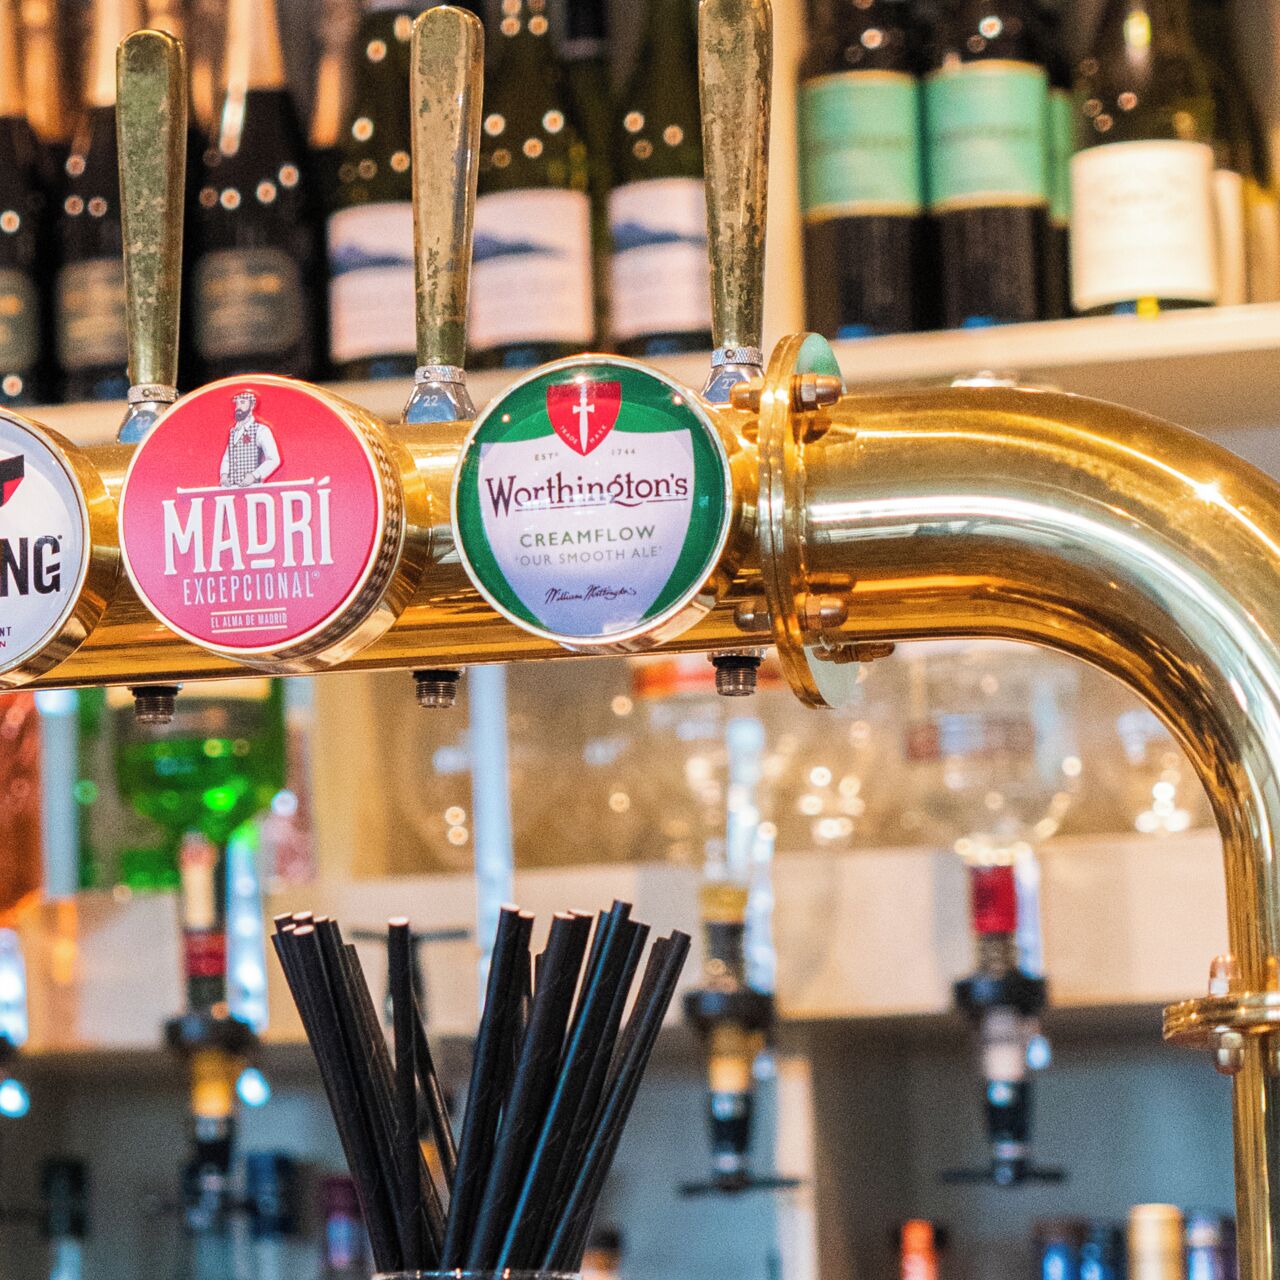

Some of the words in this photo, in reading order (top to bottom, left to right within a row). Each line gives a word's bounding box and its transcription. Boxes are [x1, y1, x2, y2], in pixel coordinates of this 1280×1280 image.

[423, 395, 439, 407] 22
[560, 425, 578, 444] TRADE
[590, 424, 607, 443] MARK
[485, 471, 689, 518] Worthington's
[162, 476, 334, 575] MADRÍ
[520, 525, 656, 548] CREAMFLOW
[559, 549, 625, 565] SMOOTH
[183, 570, 315, 606] EXCEPCIONAL
[210, 616, 220, 629] EL
[222, 615, 243, 627] ALMA
[245, 614, 255, 626] DE
[257, 612, 288, 625] MADRID
